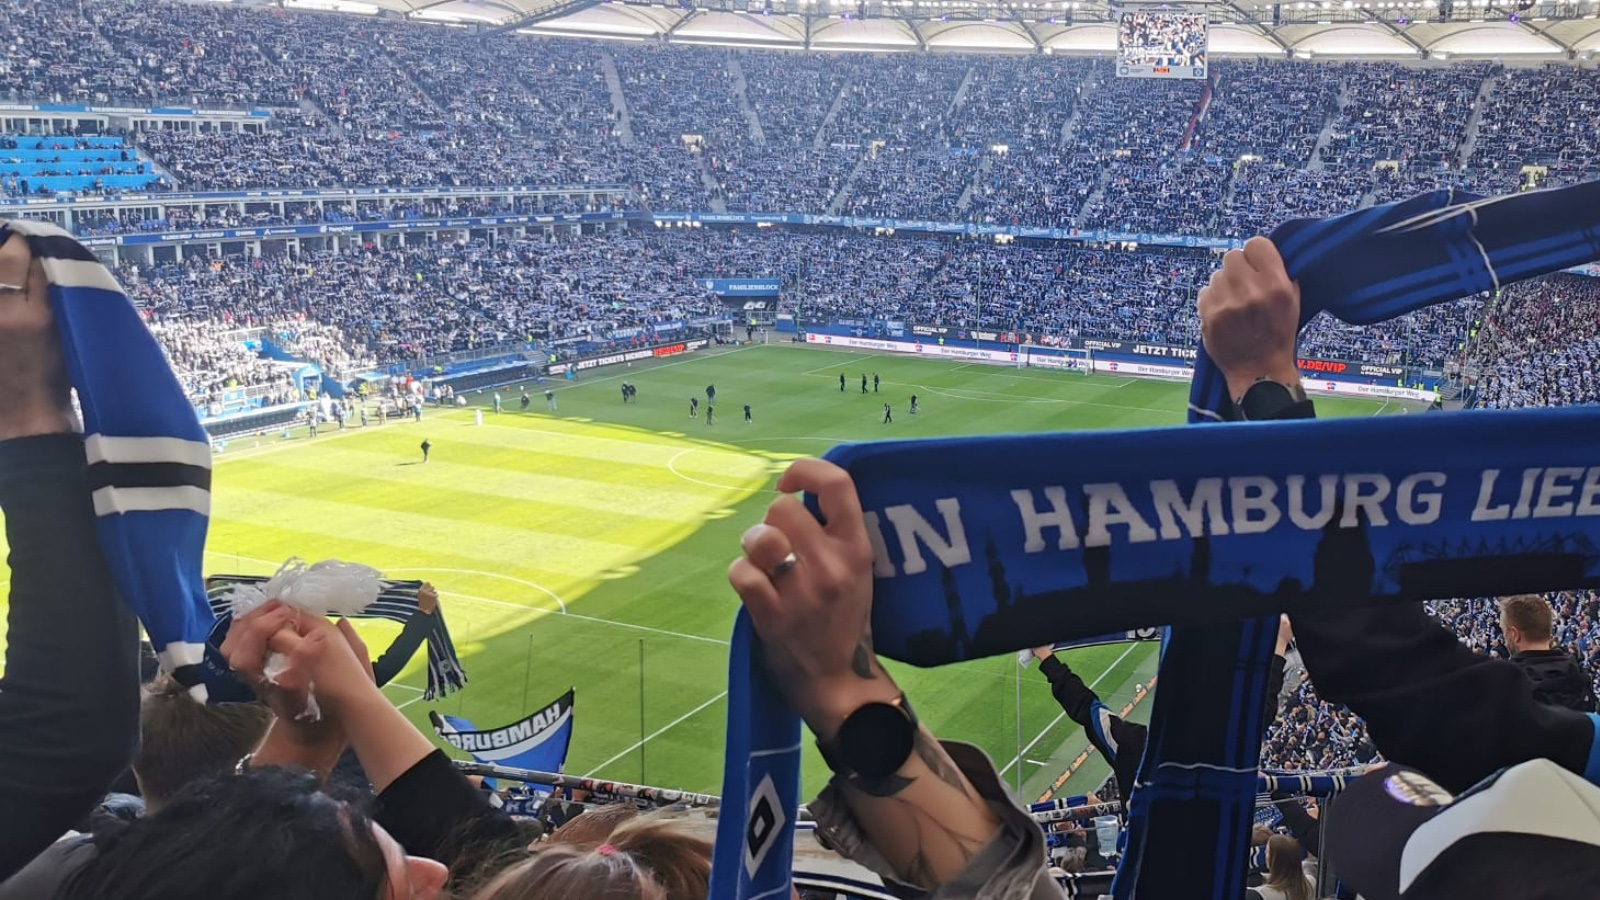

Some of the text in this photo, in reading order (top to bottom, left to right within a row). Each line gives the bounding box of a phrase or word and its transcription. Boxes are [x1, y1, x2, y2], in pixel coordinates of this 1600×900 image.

[1084, 340, 1111, 348] OFFICIAL
[1133, 345, 1167, 356] JETZT
[1149, 367, 1181, 376] Hamburger
[1361, 365, 1391, 374] OFFICIAL
[1391, 368, 1403, 376] VIP
[1370, 388, 1405, 397] Hamburger
[1406, 390, 1420, 399] Weg
[1010, 472, 1448, 554] HAMBURG
